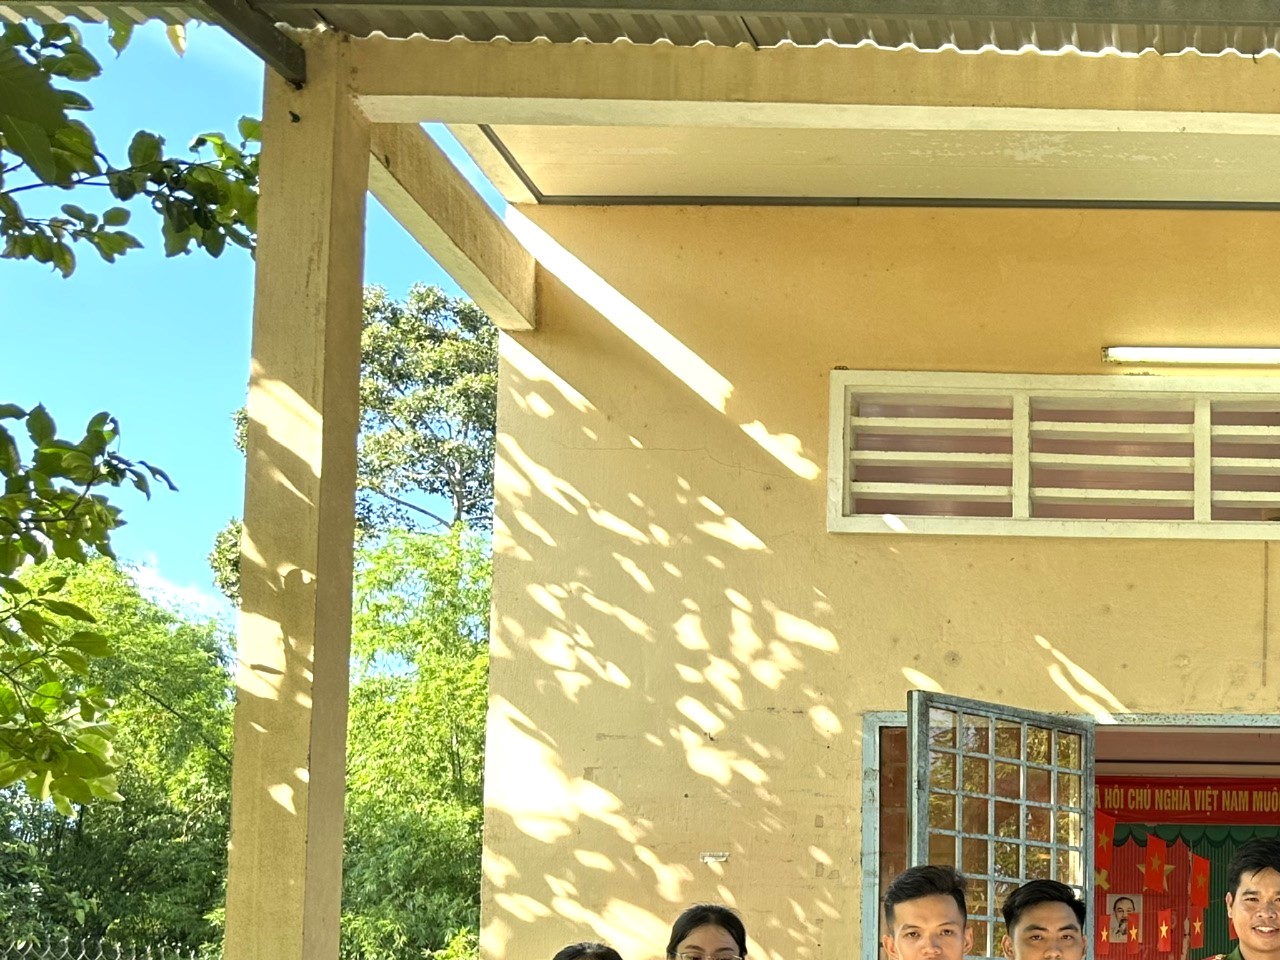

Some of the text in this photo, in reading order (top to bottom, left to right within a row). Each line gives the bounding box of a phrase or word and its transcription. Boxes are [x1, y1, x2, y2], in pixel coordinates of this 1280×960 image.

[1105, 784, 1124, 814] HỘI
[1128, 784, 1151, 809] CHỦ
[1155, 785, 1191, 811] NGHĨA
[1194, 786, 1219, 816] VIỆT
[1222, 790, 1249, 812] NAM
